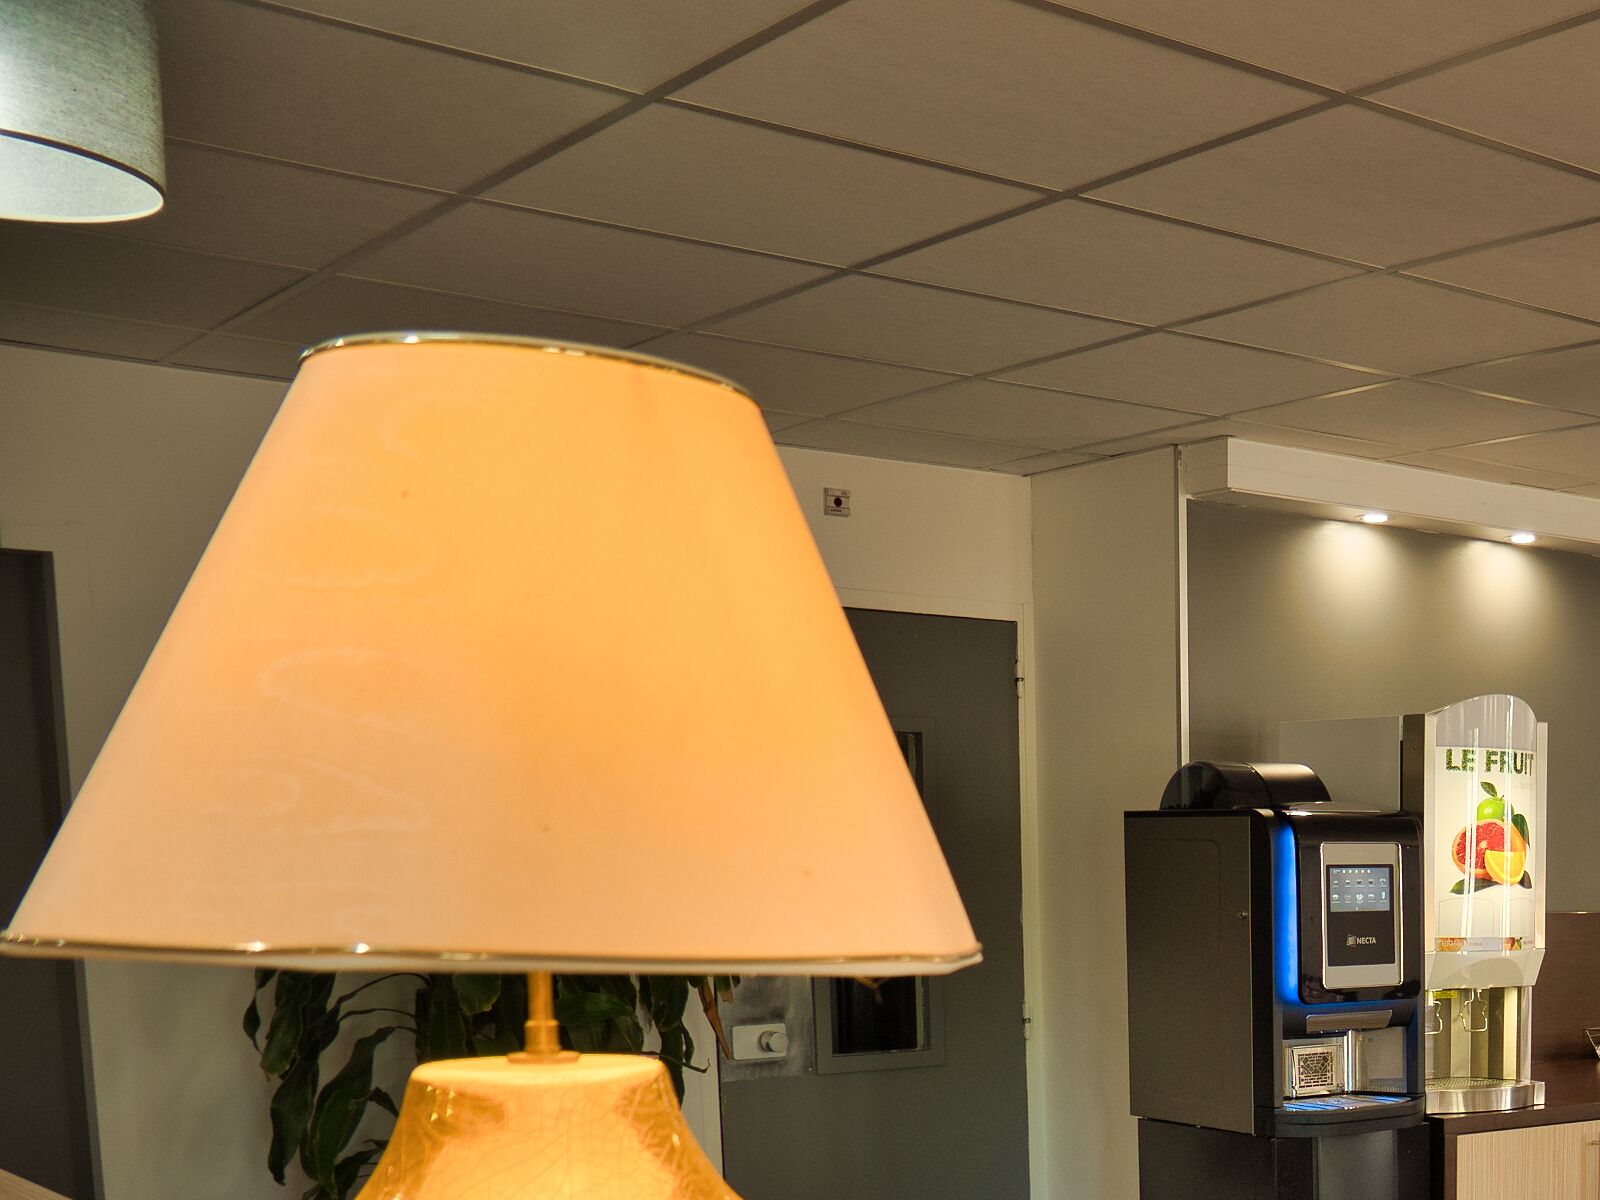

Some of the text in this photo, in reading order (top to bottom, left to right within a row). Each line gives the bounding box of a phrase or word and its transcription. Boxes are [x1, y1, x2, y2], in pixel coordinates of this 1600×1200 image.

[1446, 748, 1534, 776] LE FRUIT
[1356, 936, 1377, 945] NECTA
